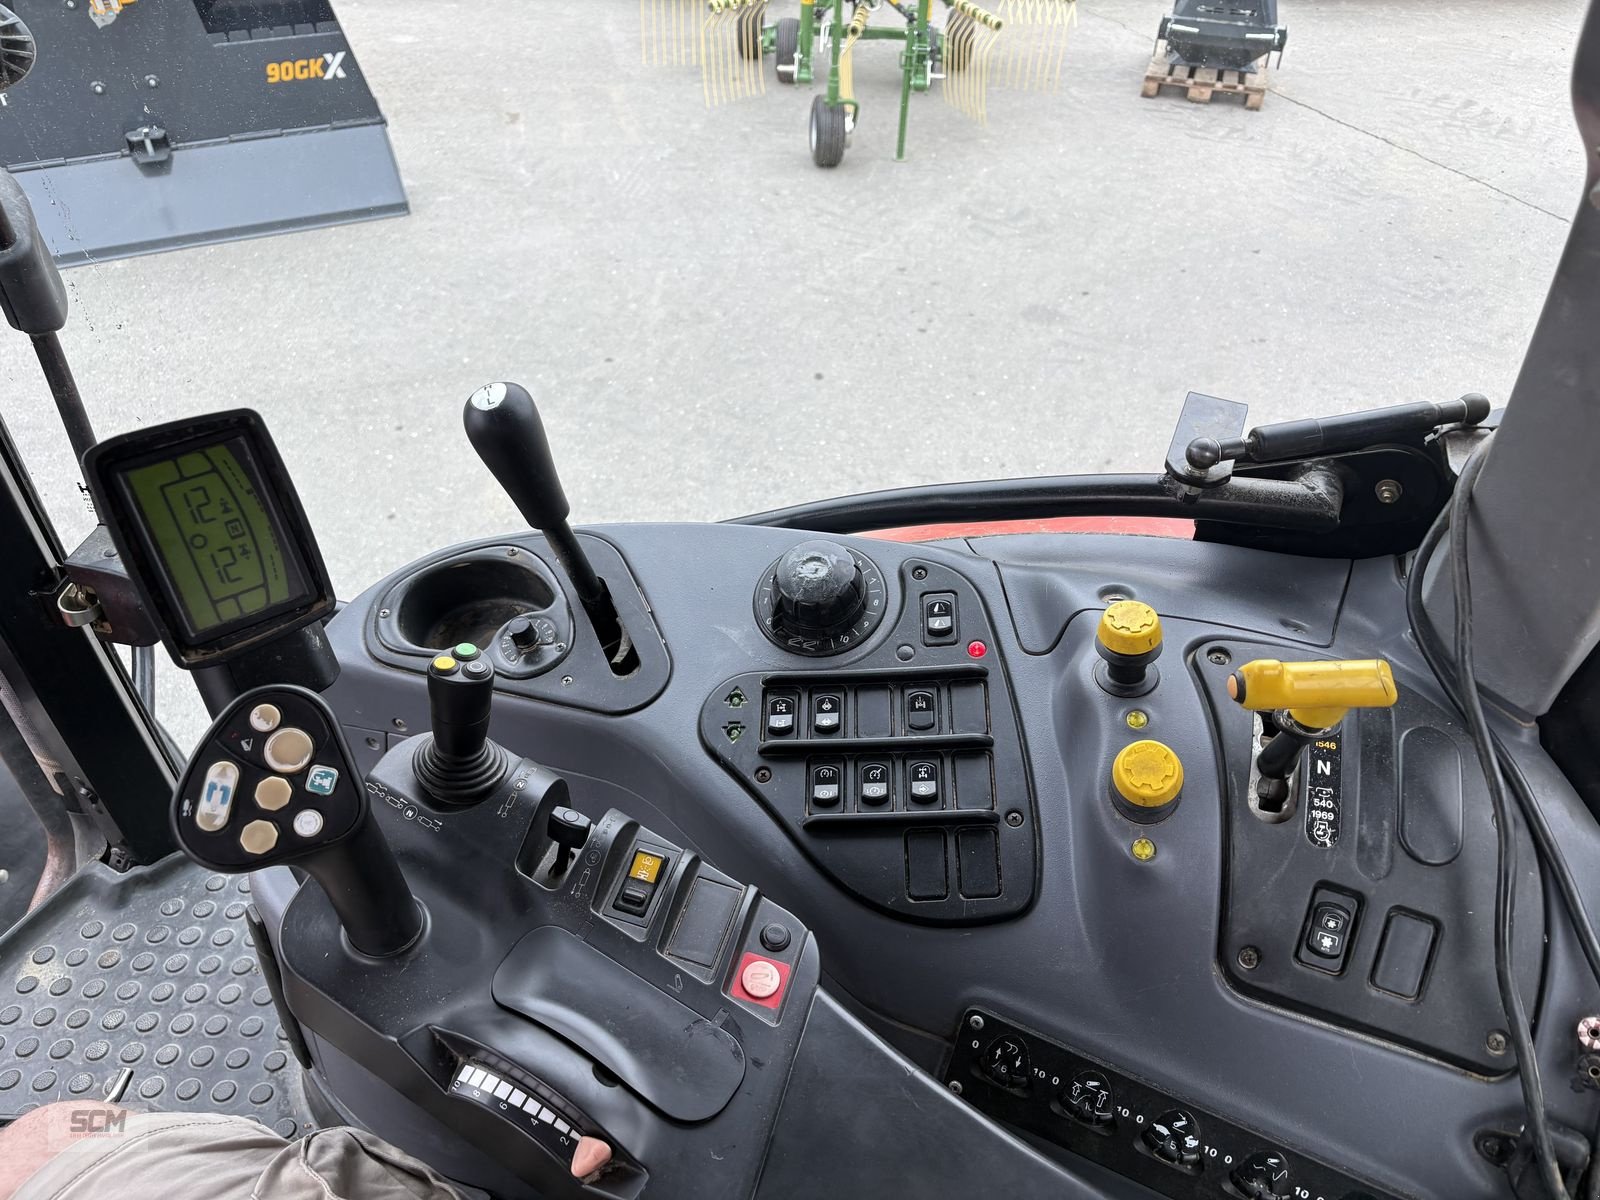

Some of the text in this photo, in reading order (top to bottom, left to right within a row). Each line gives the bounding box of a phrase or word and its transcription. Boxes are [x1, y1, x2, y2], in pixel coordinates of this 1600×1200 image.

[266, 51, 347, 84] 90GKX
[183, 486, 217, 524] 12
[210, 546, 243, 584] 12
[840, 635, 850, 643] 10
[1317, 759, 1331, 776] N
[1311, 810, 1335, 821] 1969
[1313, 798, 1333, 809] 540
[451, 1080, 570, 1146] 10 8 6 4 2
[972, 1040, 1310, 1199] 0 10 0 10 0 10 0 10
